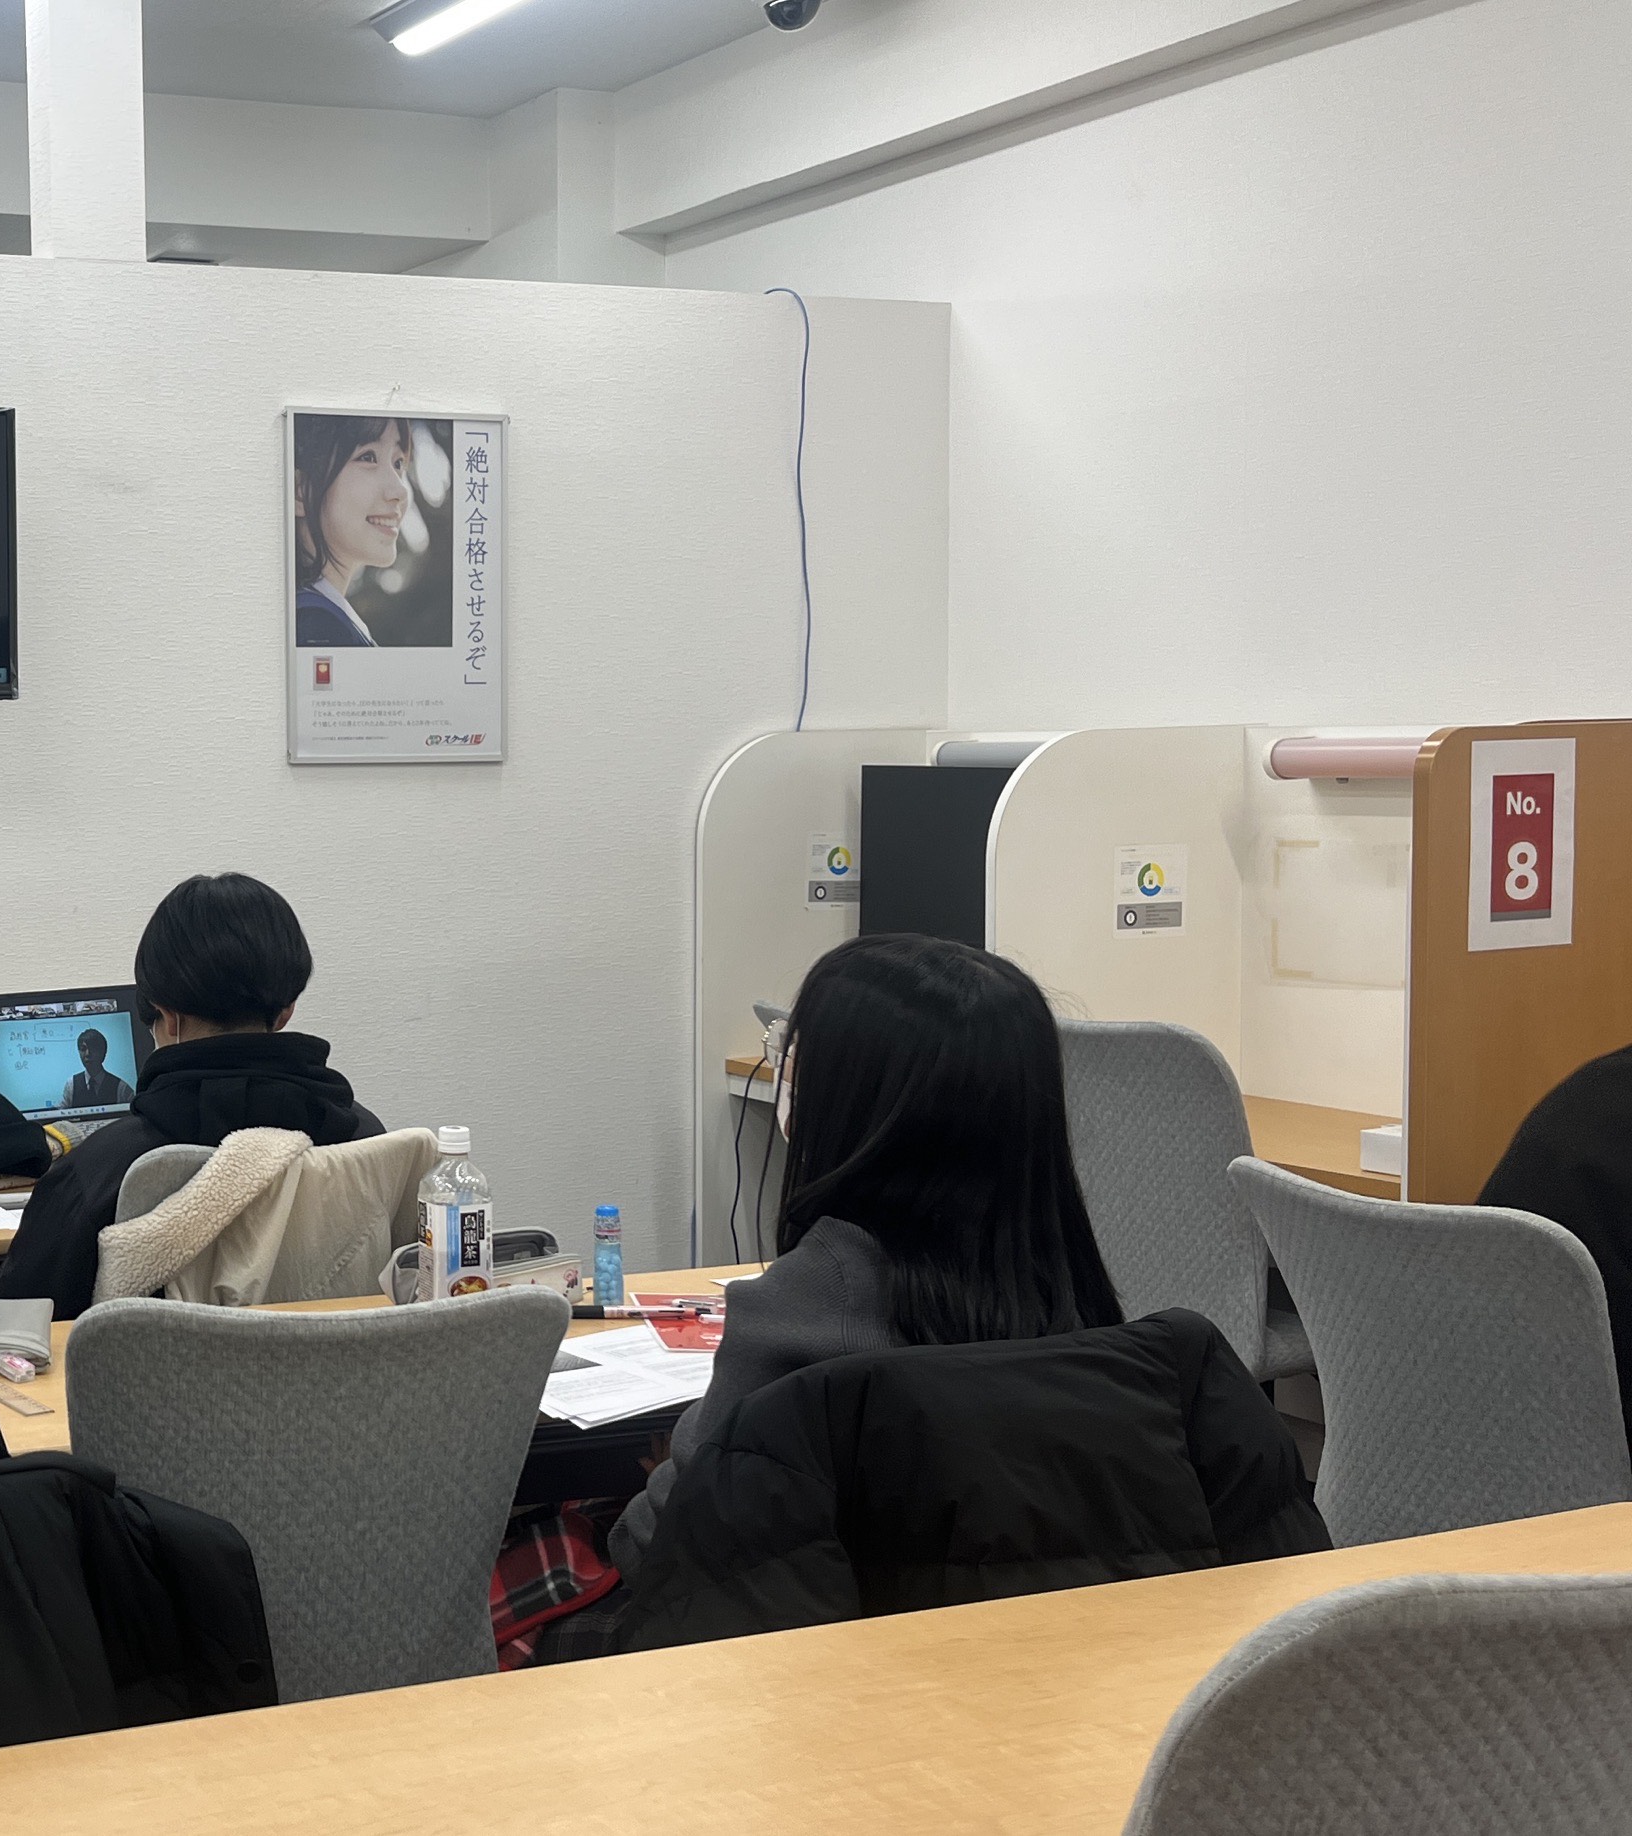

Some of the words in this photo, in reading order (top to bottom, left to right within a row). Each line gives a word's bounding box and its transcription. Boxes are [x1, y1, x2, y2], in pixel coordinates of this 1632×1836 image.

[464, 432, 489, 685] 「絶対合格させるぞ」
[1506, 791, 1541, 815] No.
[1504, 841, 1539, 901] 8
